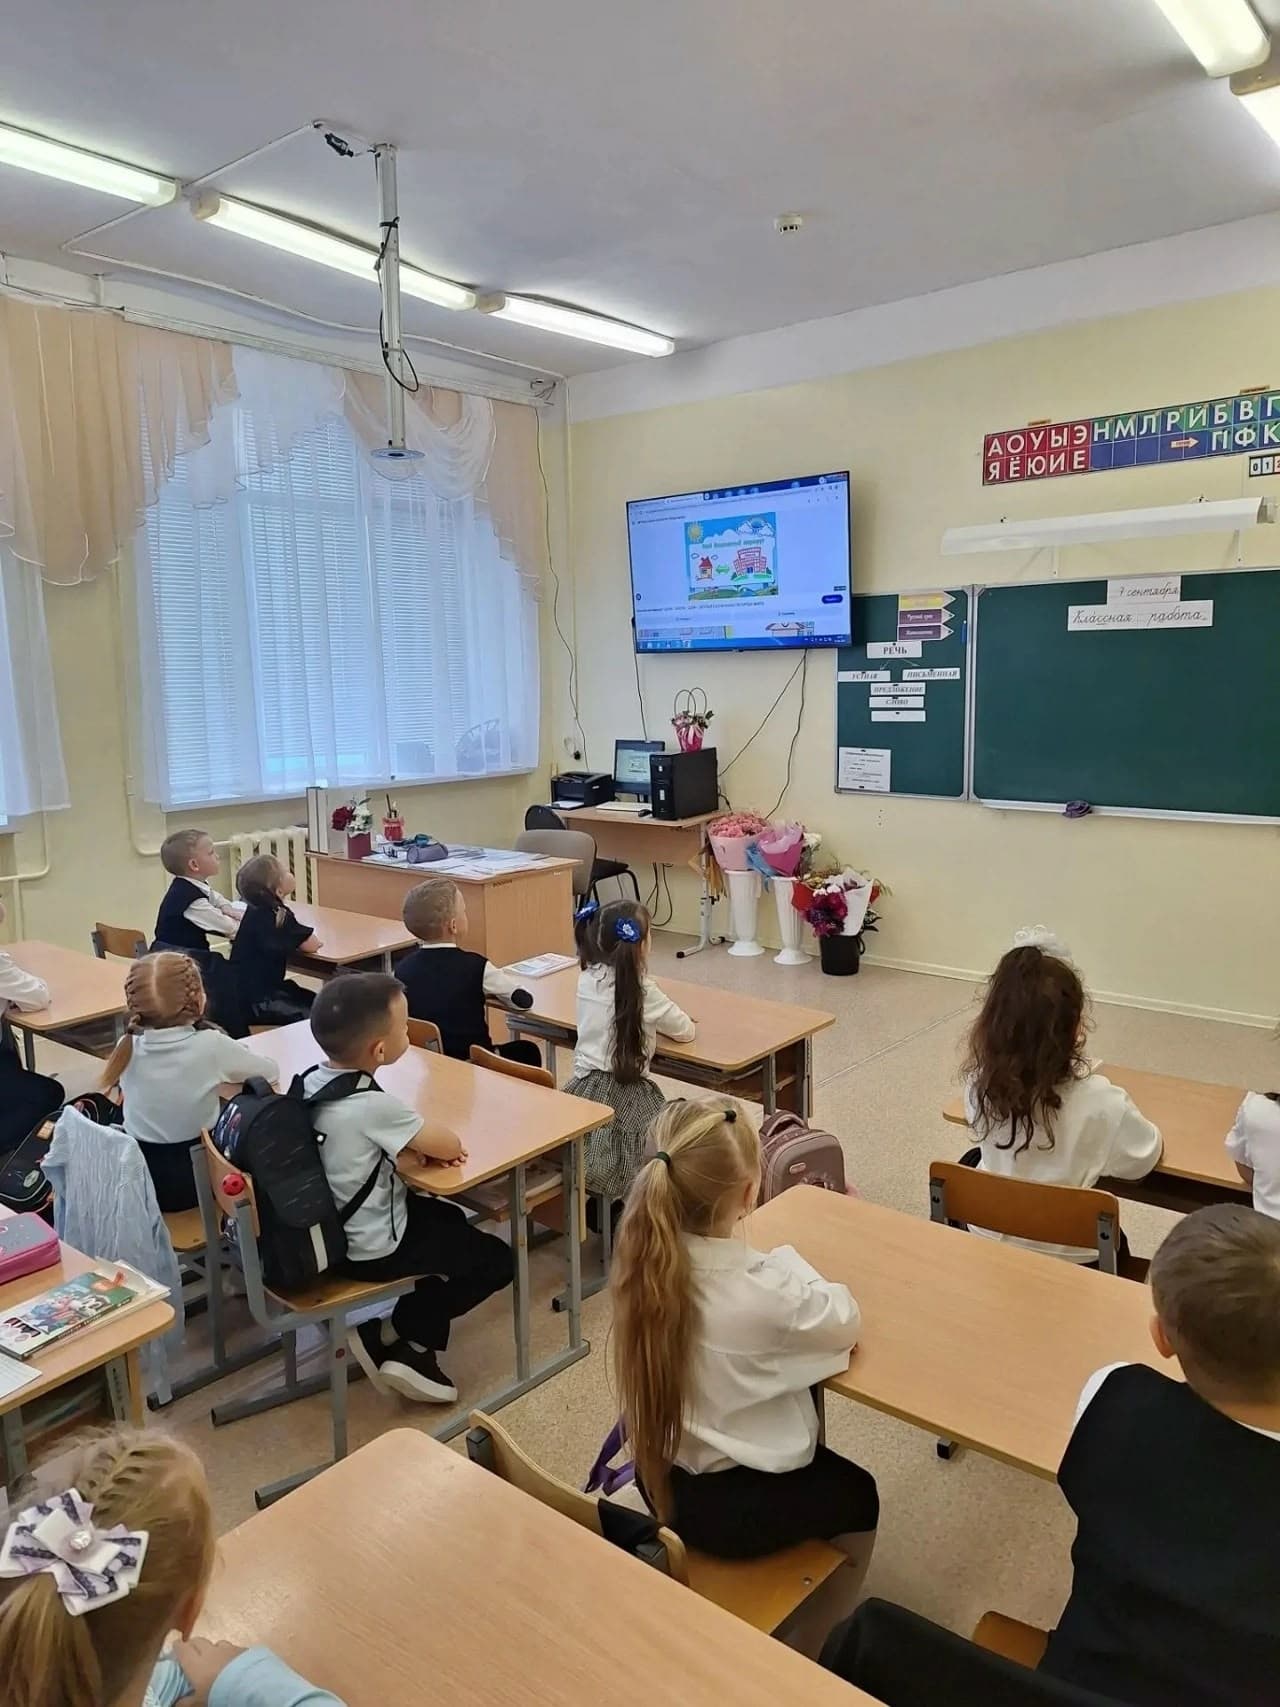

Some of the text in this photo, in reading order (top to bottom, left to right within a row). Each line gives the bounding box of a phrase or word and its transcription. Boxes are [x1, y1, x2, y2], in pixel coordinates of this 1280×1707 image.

[988, 438, 1003, 456] А
[1007, 434, 1025, 453] О
[1030, 431, 1044, 450] У
[1051, 427, 1068, 448] Ы
[1073, 426, 1087, 445] Э
[1093, 421, 1110, 441] Н
[1114, 419, 1135, 439] М
[1139, 414, 1156, 436] Л
[1166, 411, 1180, 432] Р
[1189, 405, 1207, 428] Й
[1214, 403, 1228, 425] Б
[1240, 400, 1254, 420] В
[988, 461, 1000, 480] Я
[1009, 457, 1020, 478] Ё
[1027, 456, 1046, 476] Ю
[1049, 452, 1065, 473] И
[1073, 450, 1086, 470] Е
[1212, 429, 1228, 451] П
[1234, 427, 1256, 447] Ф
[883, 647, 908, 656] РЕЧЬ
